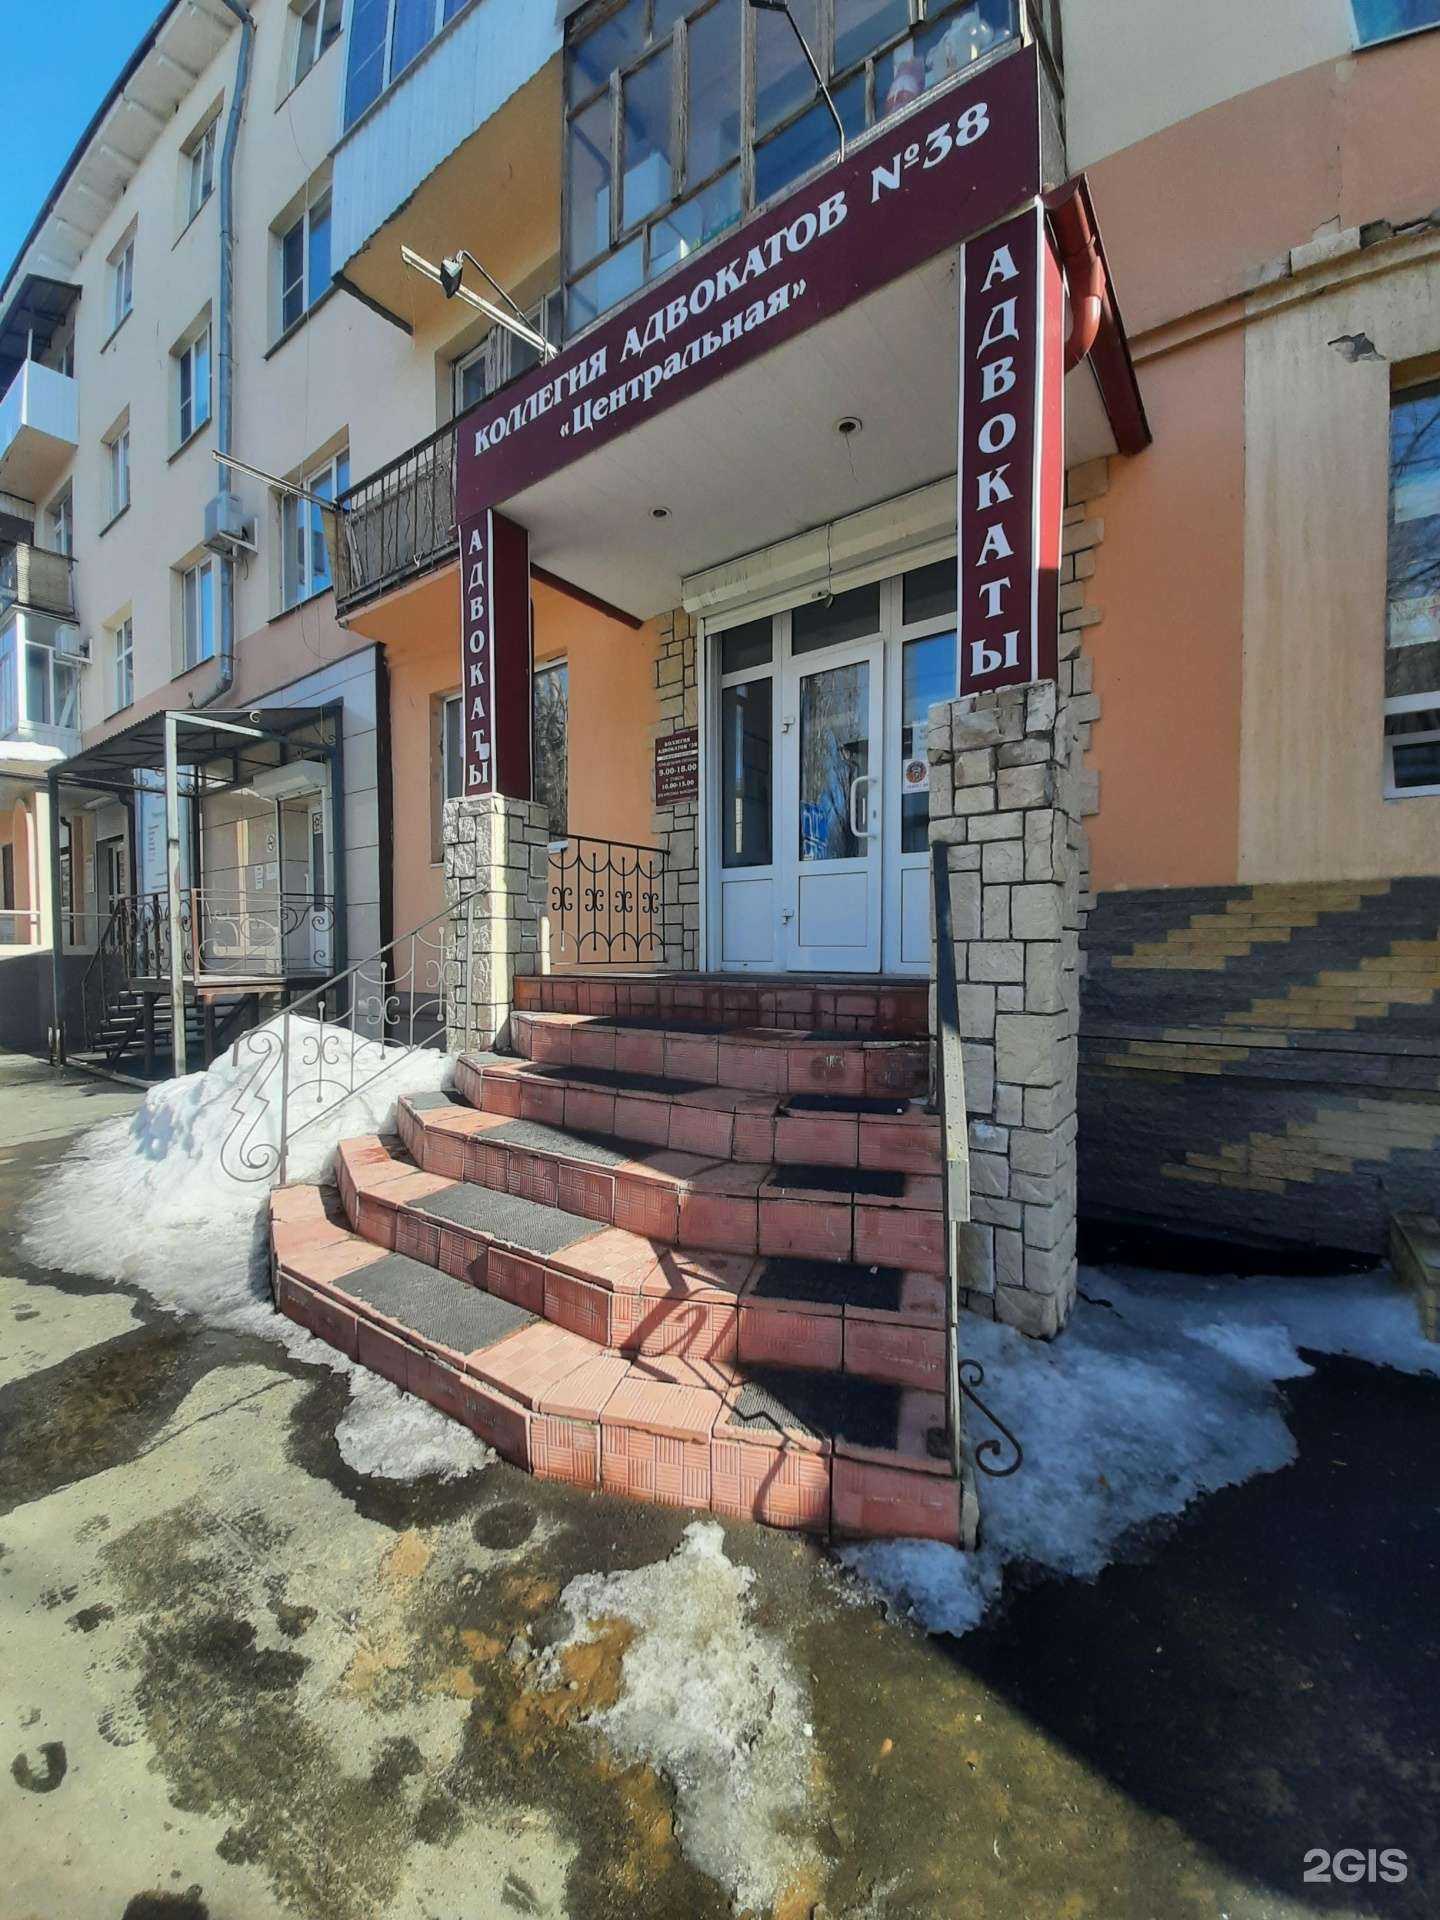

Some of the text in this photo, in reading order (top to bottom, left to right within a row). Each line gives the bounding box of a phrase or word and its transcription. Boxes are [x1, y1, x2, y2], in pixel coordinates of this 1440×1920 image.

[474, 102, 990, 457] КОЛЛЕГИЯ АДВОКАТОВ №38
[560, 279, 806, 438] «Центральная»
[970, 243, 1020, 677] АДВОКАТЫ
[468, 528, 489, 786] АДВОКАТЫ
